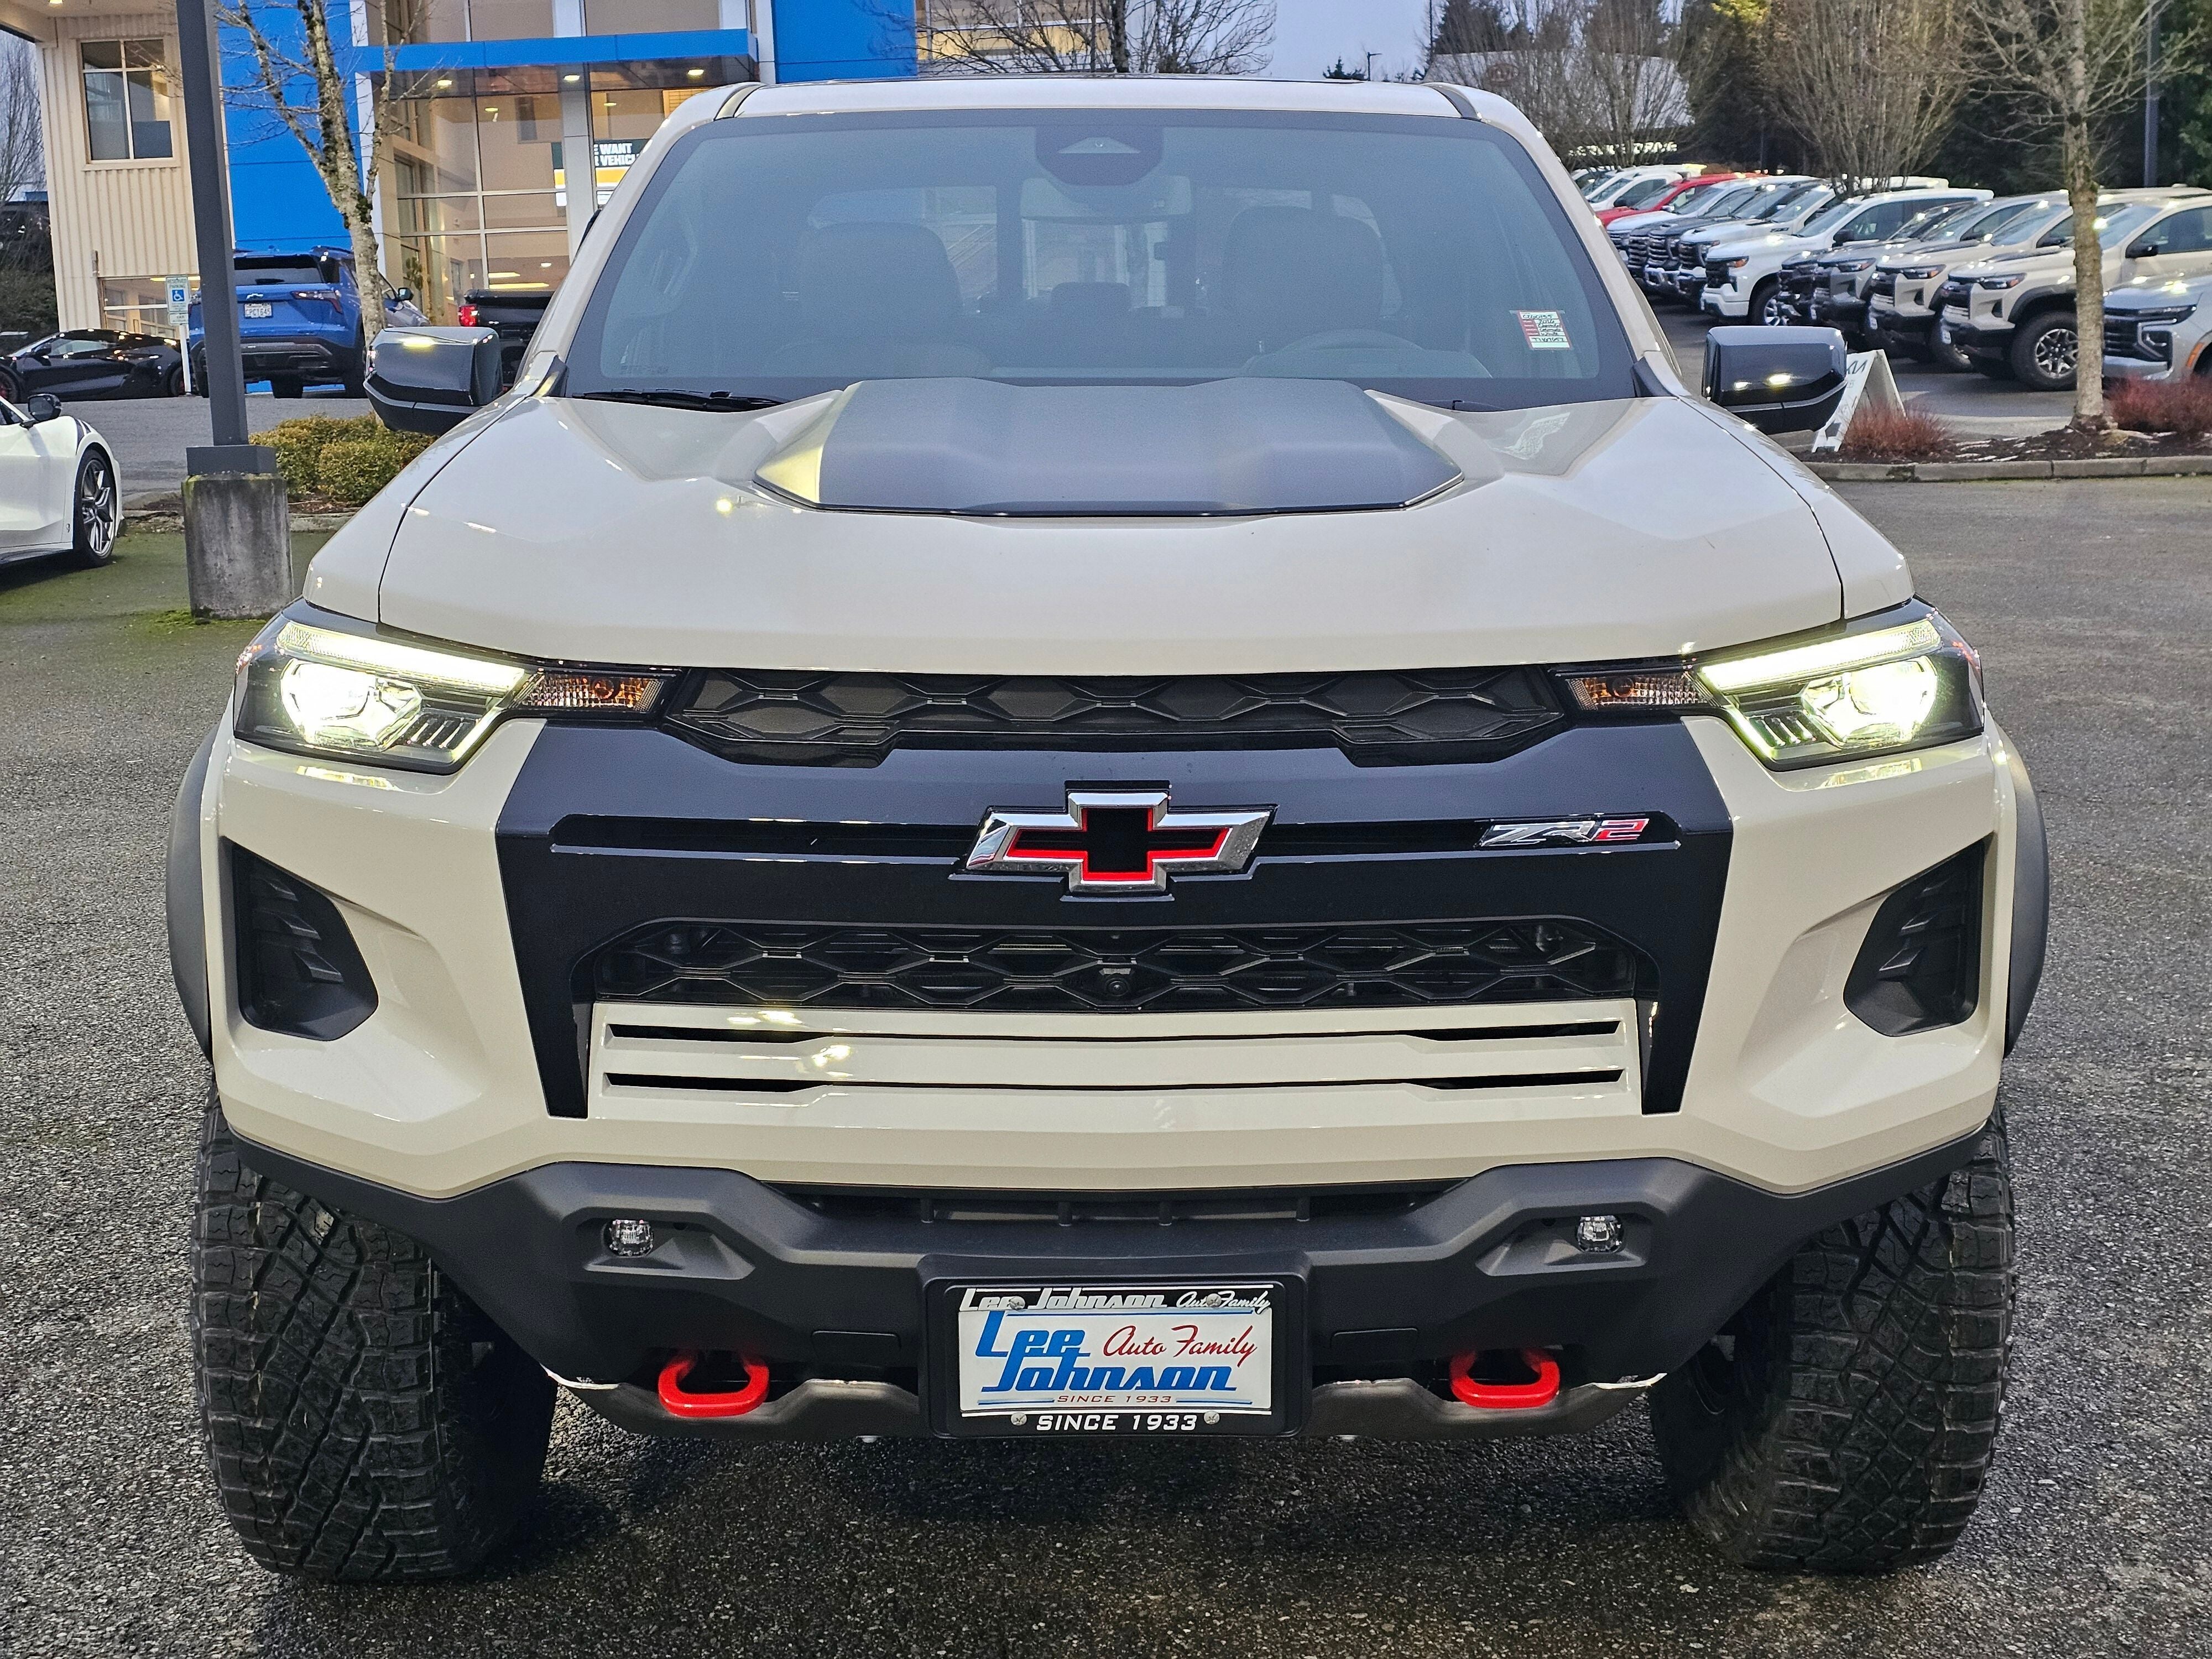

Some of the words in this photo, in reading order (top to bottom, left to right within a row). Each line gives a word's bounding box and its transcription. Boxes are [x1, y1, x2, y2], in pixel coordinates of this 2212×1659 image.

[599, 143, 633, 155] WANT
[1633, 141, 1677, 155] DRIVE
[599, 153, 640, 166] VEHICL
[1477, 818, 1650, 847] ZR2
[1027, 1287, 1167, 1310] Johnson
[1176, 1291, 1213, 1308] Aut
[1218, 1290, 1271, 1314] Family
[975, 1310, 1091, 1358] Lee
[1103, 1325, 1167, 1357] Auto
[1171, 1324, 1258, 1368] Family
[981, 1356, 1238, 1392] Johnson
[1057, 1395, 1116, 1404] SINCE
[1125, 1395, 1172, 1404] 1933
[1036, 1415, 1119, 1431] SINCE
[1132, 1415, 1198, 1431] 1933
